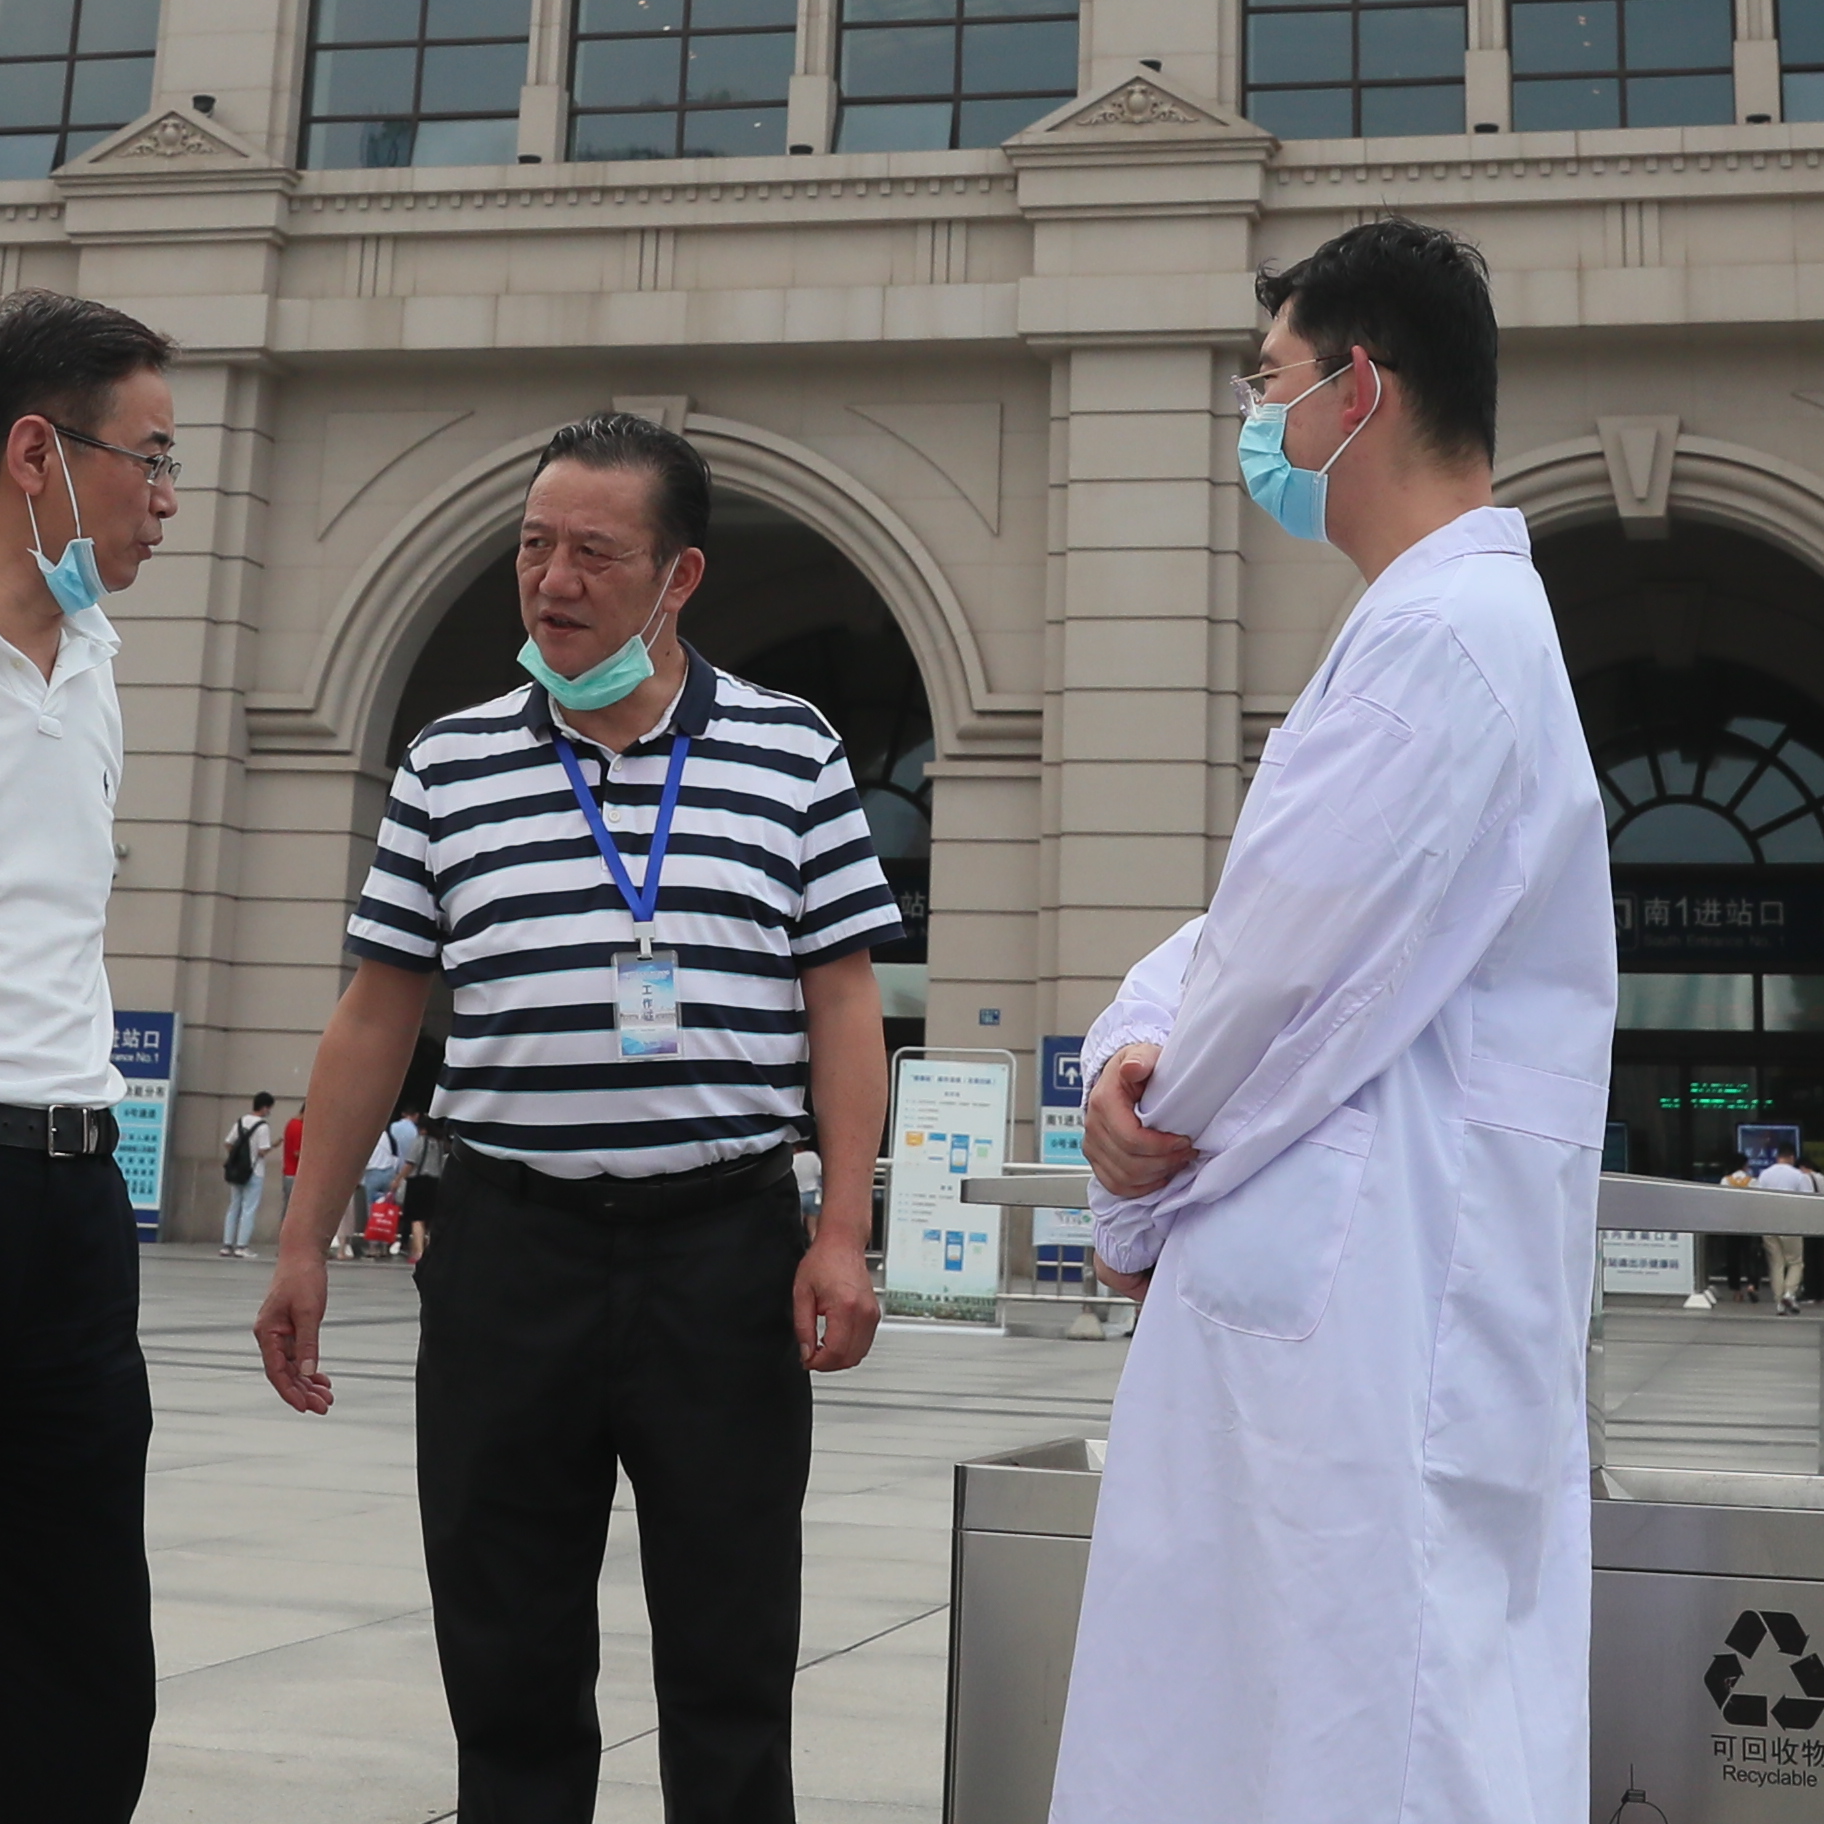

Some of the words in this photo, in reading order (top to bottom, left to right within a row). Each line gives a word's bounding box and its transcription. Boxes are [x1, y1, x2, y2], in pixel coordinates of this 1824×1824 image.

[1644, 897, 1785, 927] 南1进站口
[1723, 1763, 1818, 1788] Recyclable
